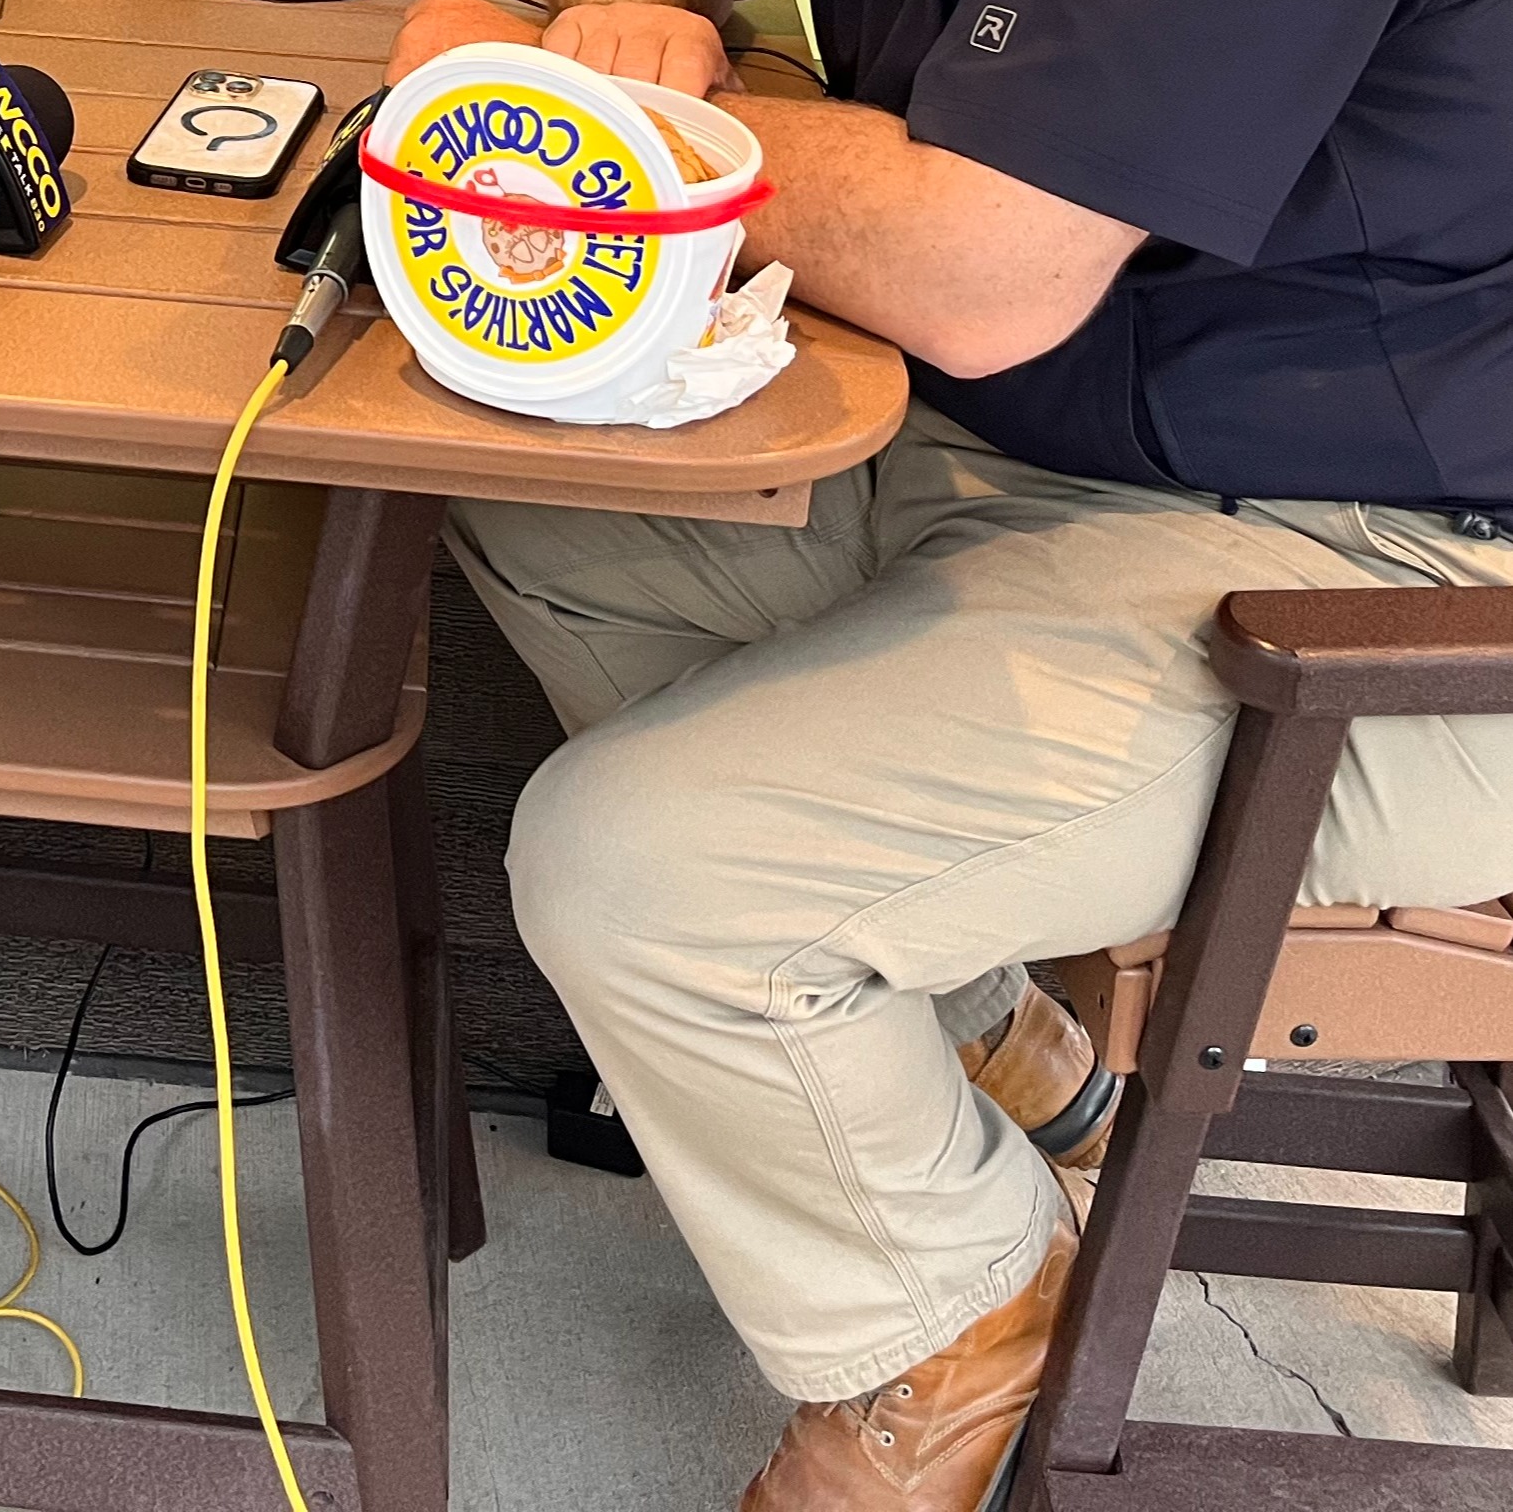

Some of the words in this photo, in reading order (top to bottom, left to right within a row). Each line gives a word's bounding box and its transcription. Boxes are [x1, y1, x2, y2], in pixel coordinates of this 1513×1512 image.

[10, 151, 34, 197] TALK
[419, 99, 580, 181] COOKIE
[404, 169, 447, 258] AR
[430, 265, 613, 352] MARTHA'S
